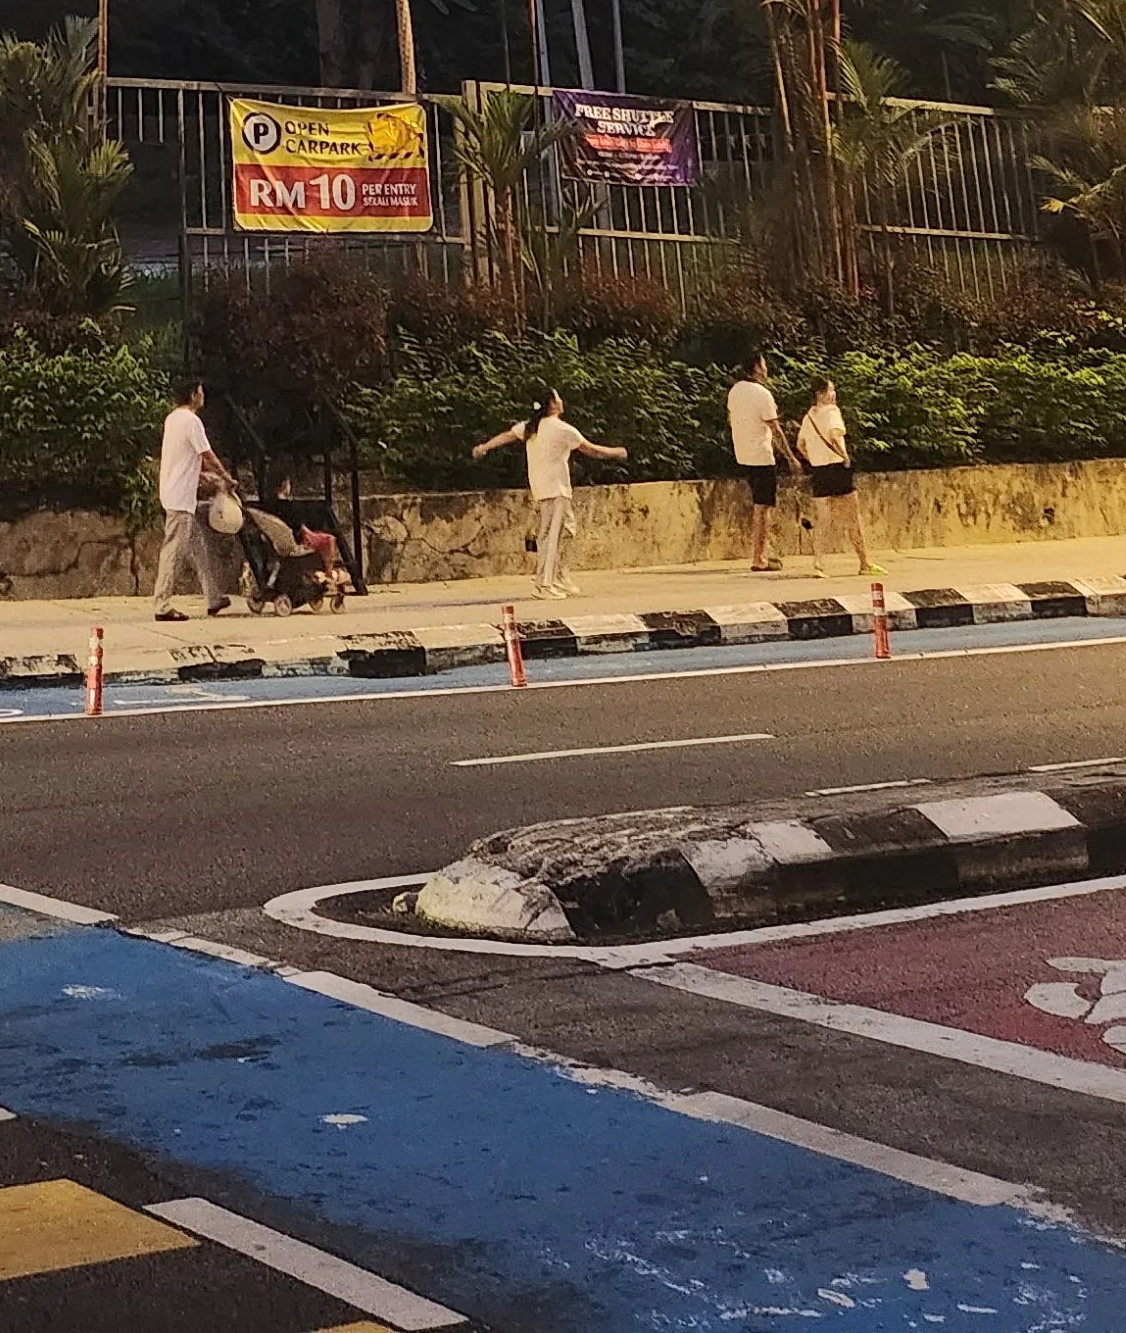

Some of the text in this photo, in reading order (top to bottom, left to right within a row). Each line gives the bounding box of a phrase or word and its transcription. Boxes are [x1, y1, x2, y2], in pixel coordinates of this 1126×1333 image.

[575, 103, 674, 123] FREE SHUTTLE
[253, 122, 269, 144] P
[285, 121, 329, 136] OPEN
[597, 120, 656, 136] SERVICE
[285, 139, 362, 155] CARPARK
[250, 173, 356, 211] RM 10
[362, 183, 417, 196] PER ENTRY
